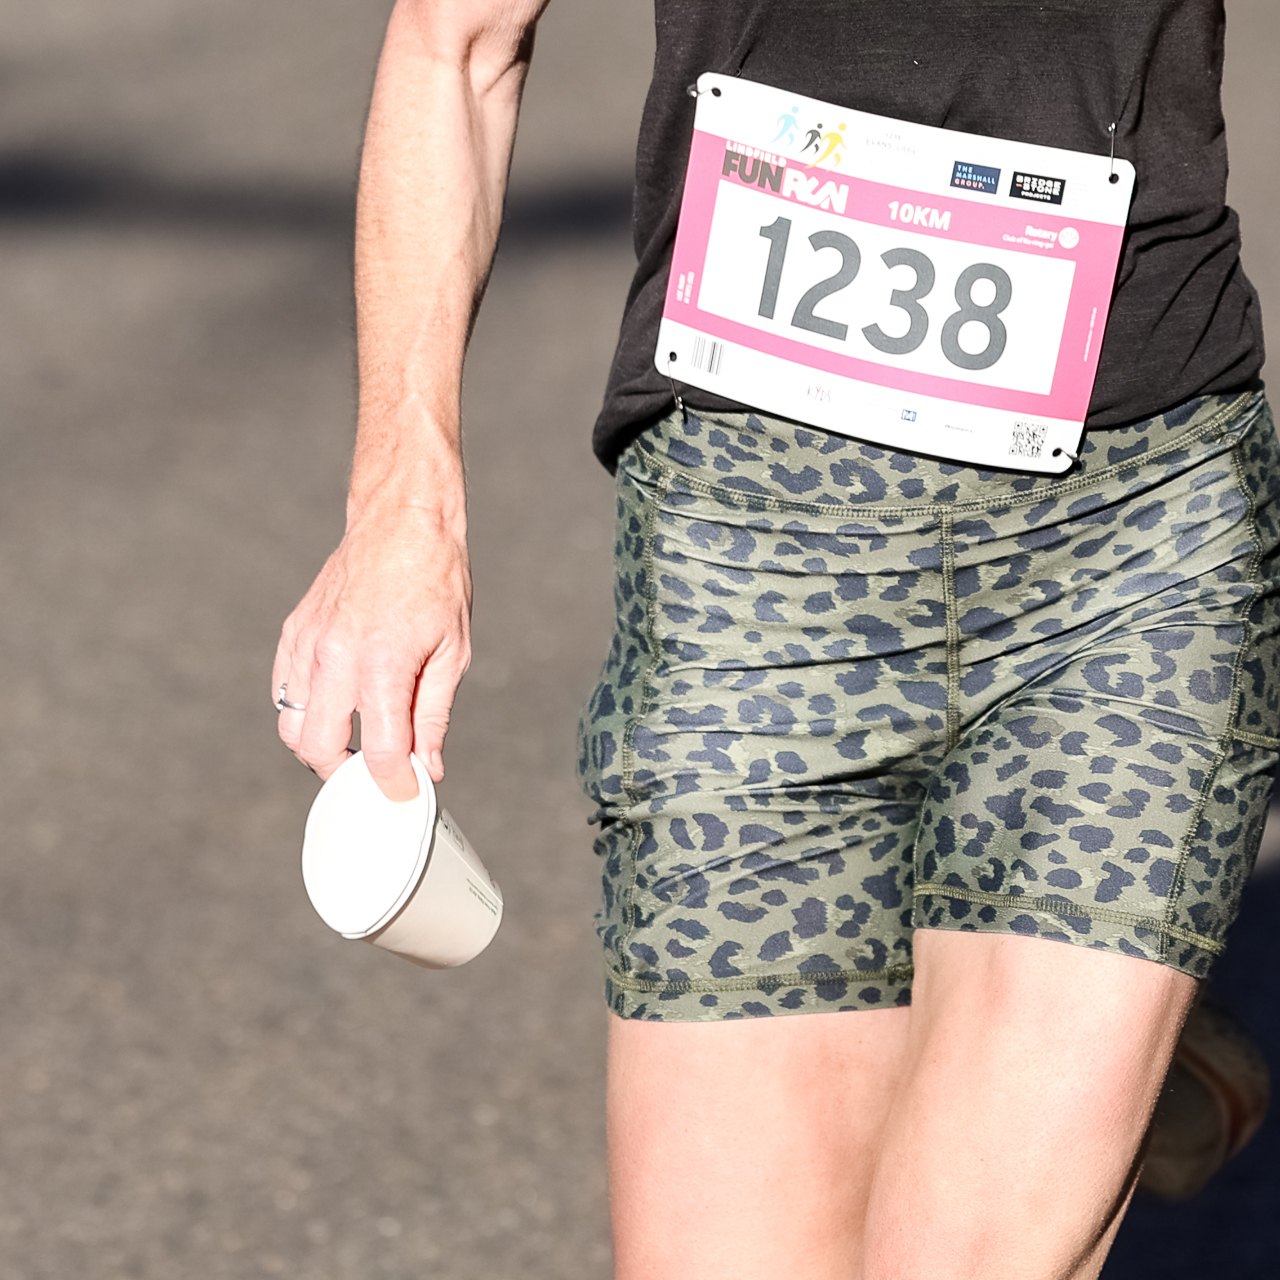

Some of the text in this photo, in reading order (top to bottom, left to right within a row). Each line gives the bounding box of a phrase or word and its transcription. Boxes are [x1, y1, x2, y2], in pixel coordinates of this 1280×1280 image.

[726, 140, 787, 168] LINDFIELD
[955, 172, 996, 185] MARSHALL
[957, 165, 973, 173] THE
[722, 149, 850, 215] FUN RUN
[1016, 174, 1061, 187] BRIDGE
[888, 201, 951, 231] 10KM
[1025, 225, 1058, 242] Rotary
[757, 216, 1013, 370] 1238
